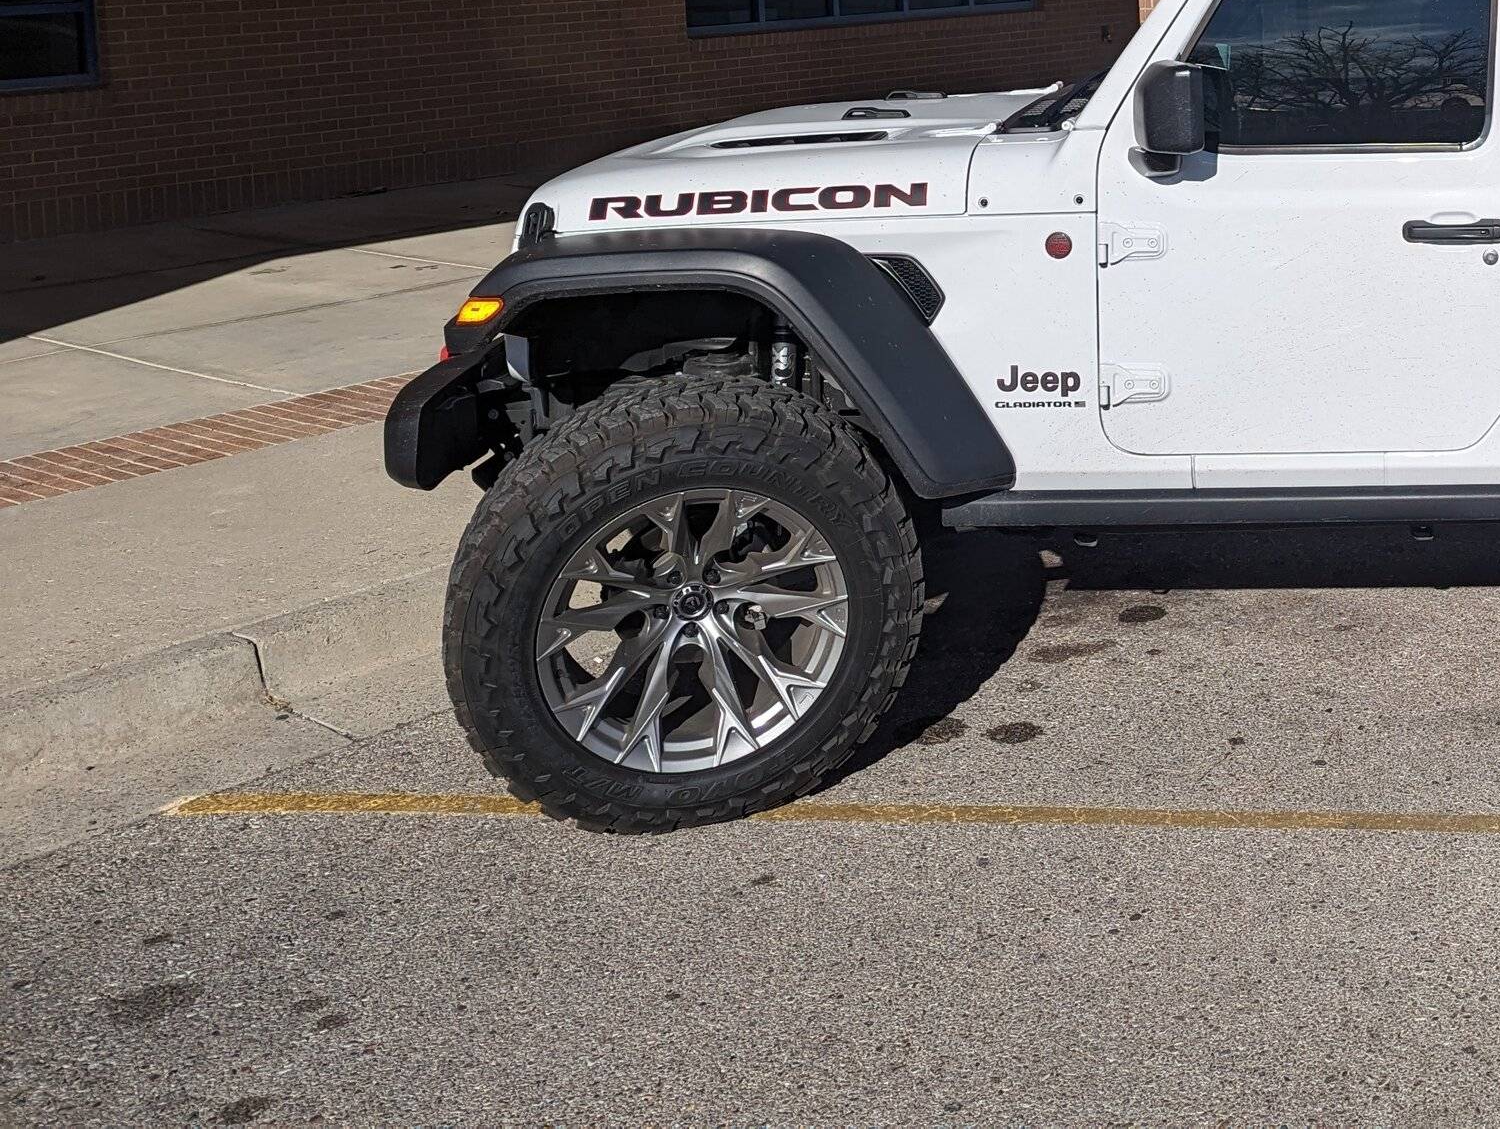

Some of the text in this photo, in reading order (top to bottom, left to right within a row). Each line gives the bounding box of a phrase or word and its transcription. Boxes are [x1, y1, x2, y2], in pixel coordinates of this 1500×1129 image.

[588, 182, 928, 221] RUBICON
[996, 365, 1081, 397] Jeep
[556, 460, 845, 541] OPEN COUNTRY
